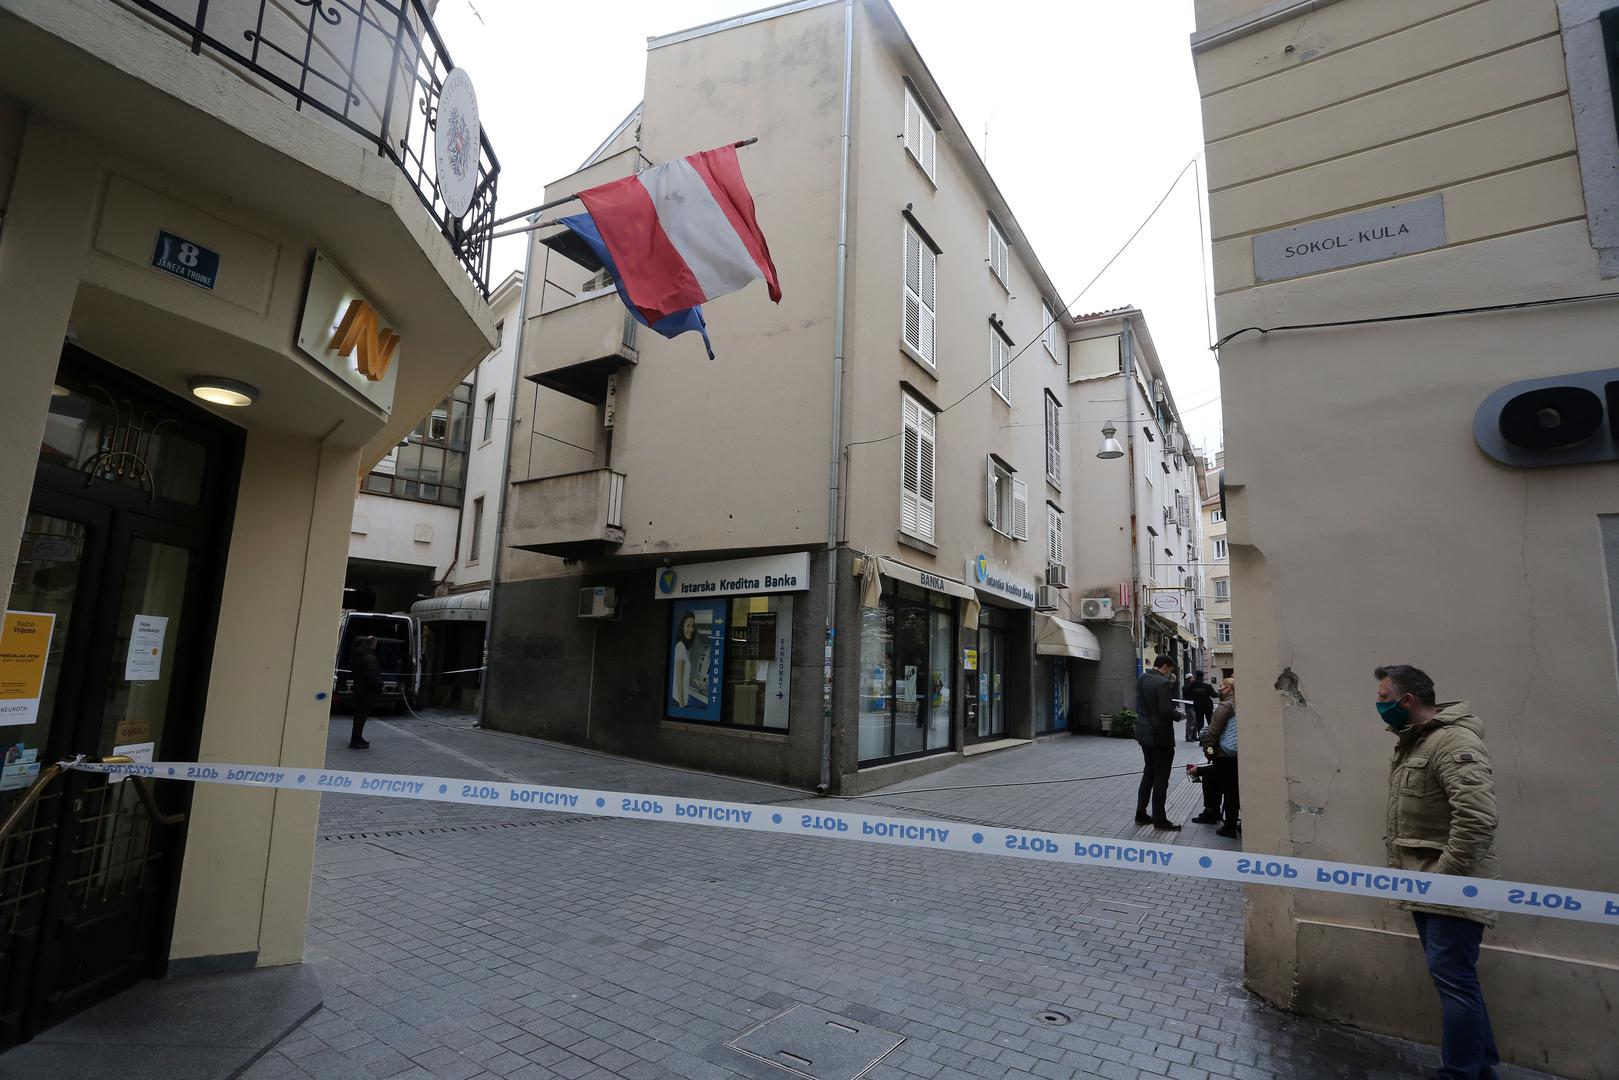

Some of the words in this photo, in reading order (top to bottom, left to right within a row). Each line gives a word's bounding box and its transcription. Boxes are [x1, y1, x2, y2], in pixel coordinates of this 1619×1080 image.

[177, 242, 200, 268] 8
[156, 258, 186, 276] JANEZA
[186, 268, 212, 286] TRDINE
[681, 580, 716, 594] Istarska
[719, 577, 760, 591] Kreditna
[764, 573, 797, 588] Banka
[920, 572, 945, 590] BANKA
[712, 630, 721, 704] BANKOMAT
